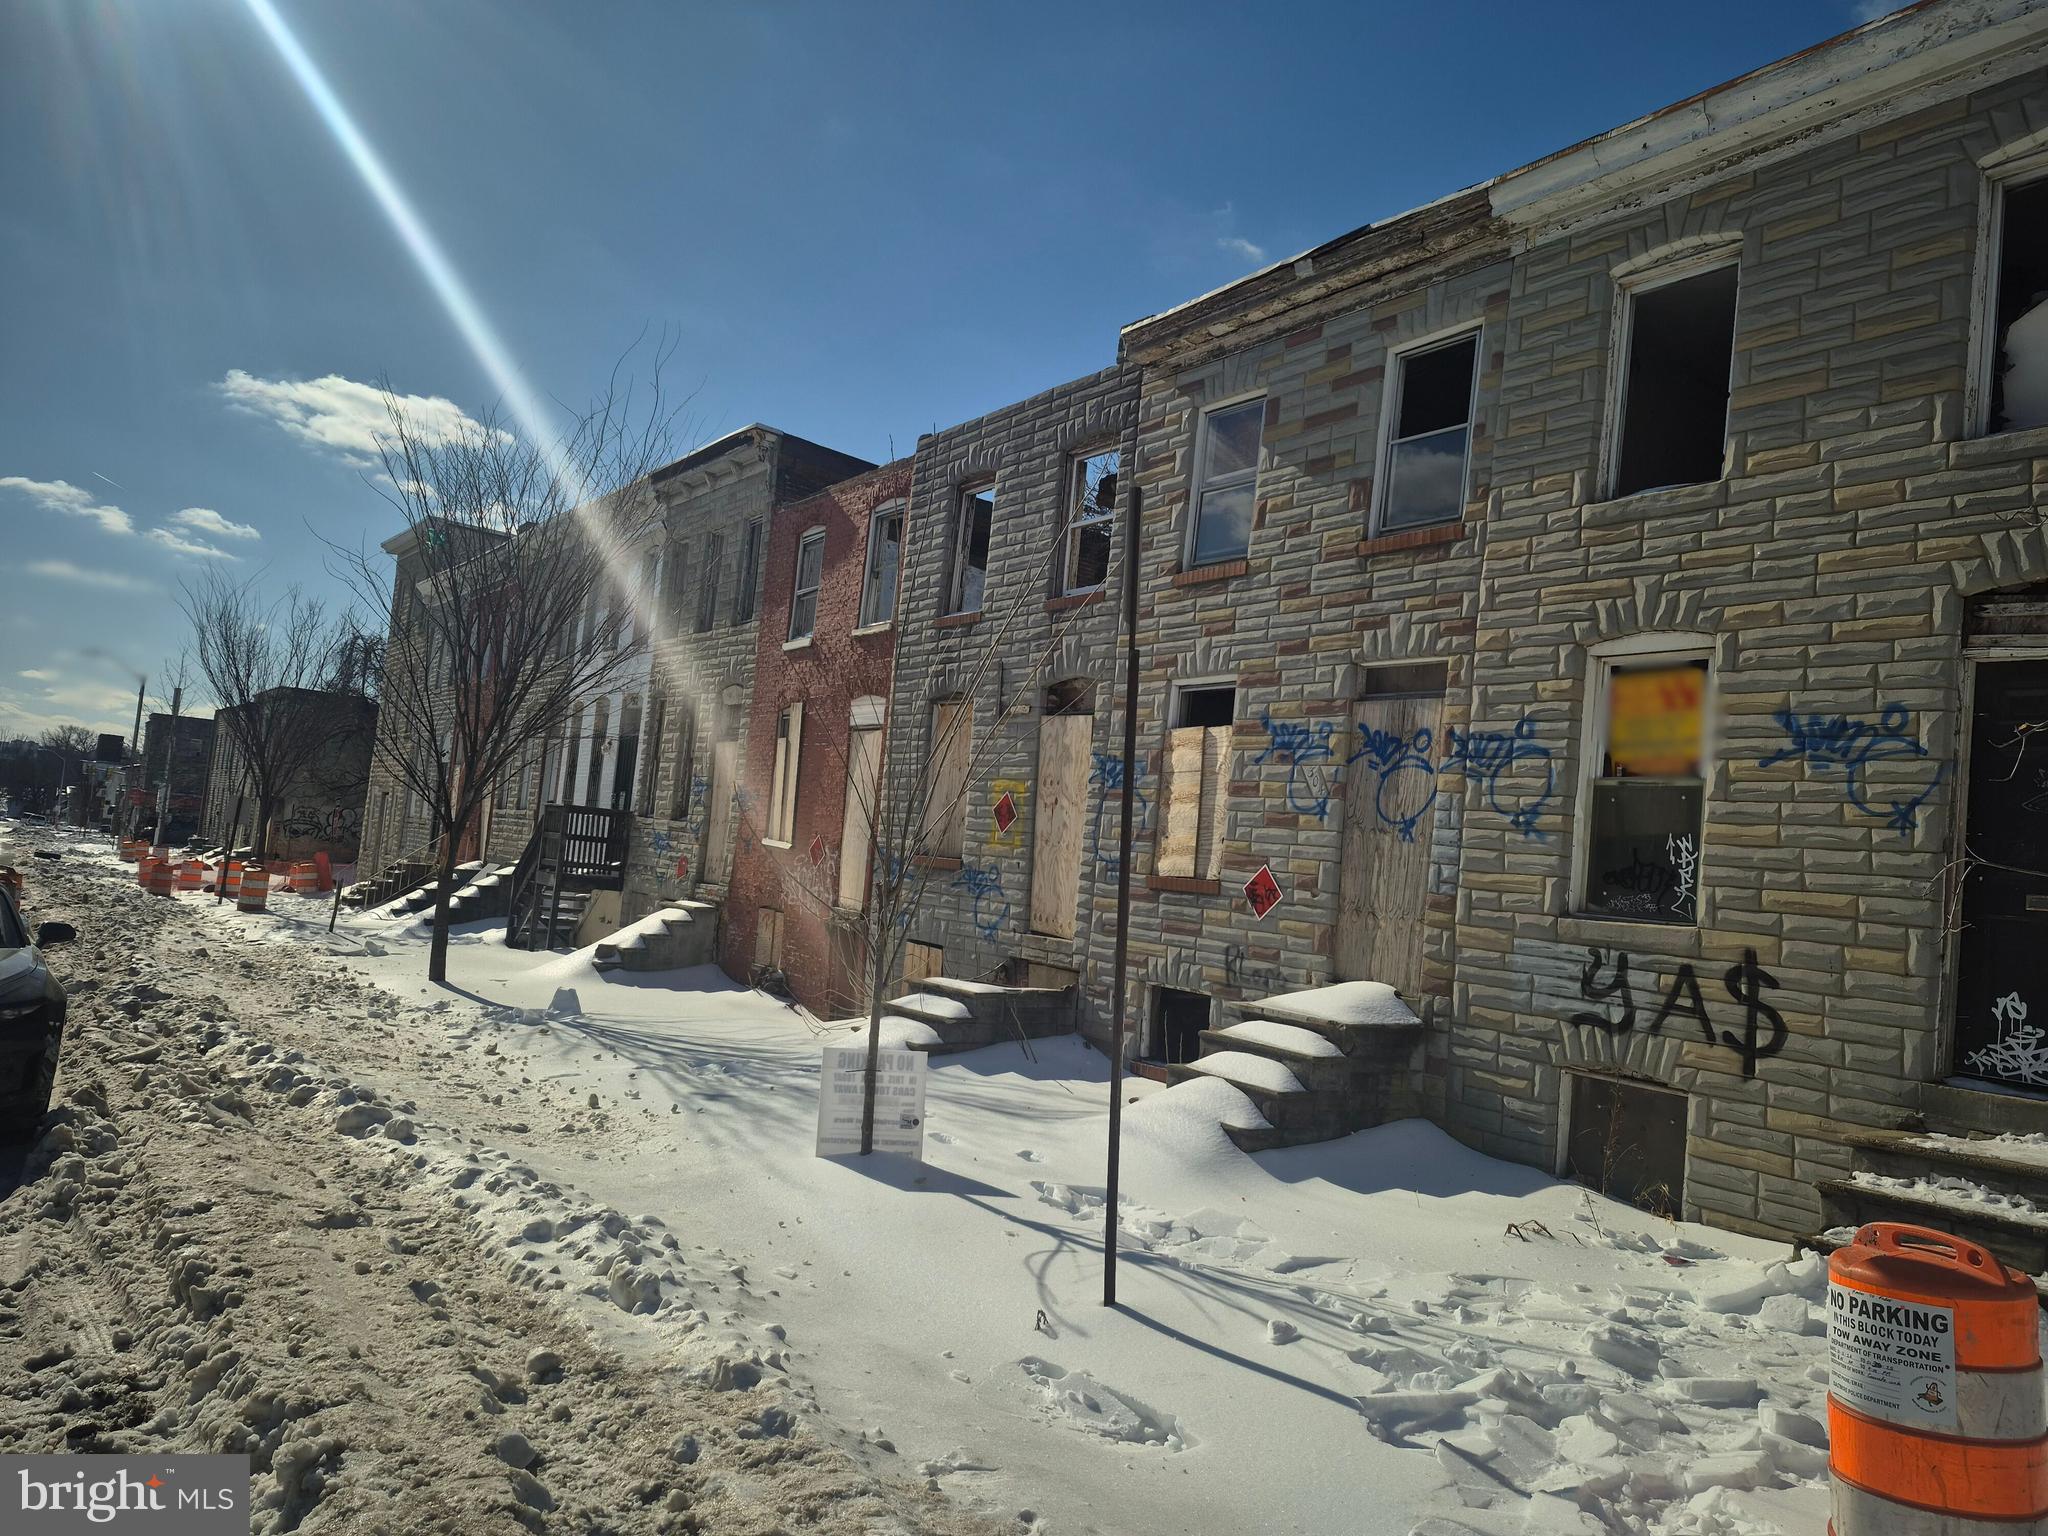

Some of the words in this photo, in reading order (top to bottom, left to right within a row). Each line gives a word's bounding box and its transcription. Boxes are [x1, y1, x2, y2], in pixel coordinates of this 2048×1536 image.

[1830, 1288, 1845, 1310] NO
[1849, 1295, 1948, 1333] PARKING
[1833, 1326, 1850, 1341] TOW
[1853, 1335, 1891, 1352] AWAY
[1896, 1346, 1942, 1362] ZONE
[1839, 1314, 1856, 1330] THIS
[1858, 1322, 1895, 1340] BLOCK
[1896, 1330, 1939, 1347] TODAY
[1831, 1337, 1861, 1355] DEPARTMENT
[1862, 1349, 1872, 1358] OF
[1872, 1352, 1944, 1374] TRANSPORTATION
[1863, 1394, 1900, 1410] DEPARTMENT
